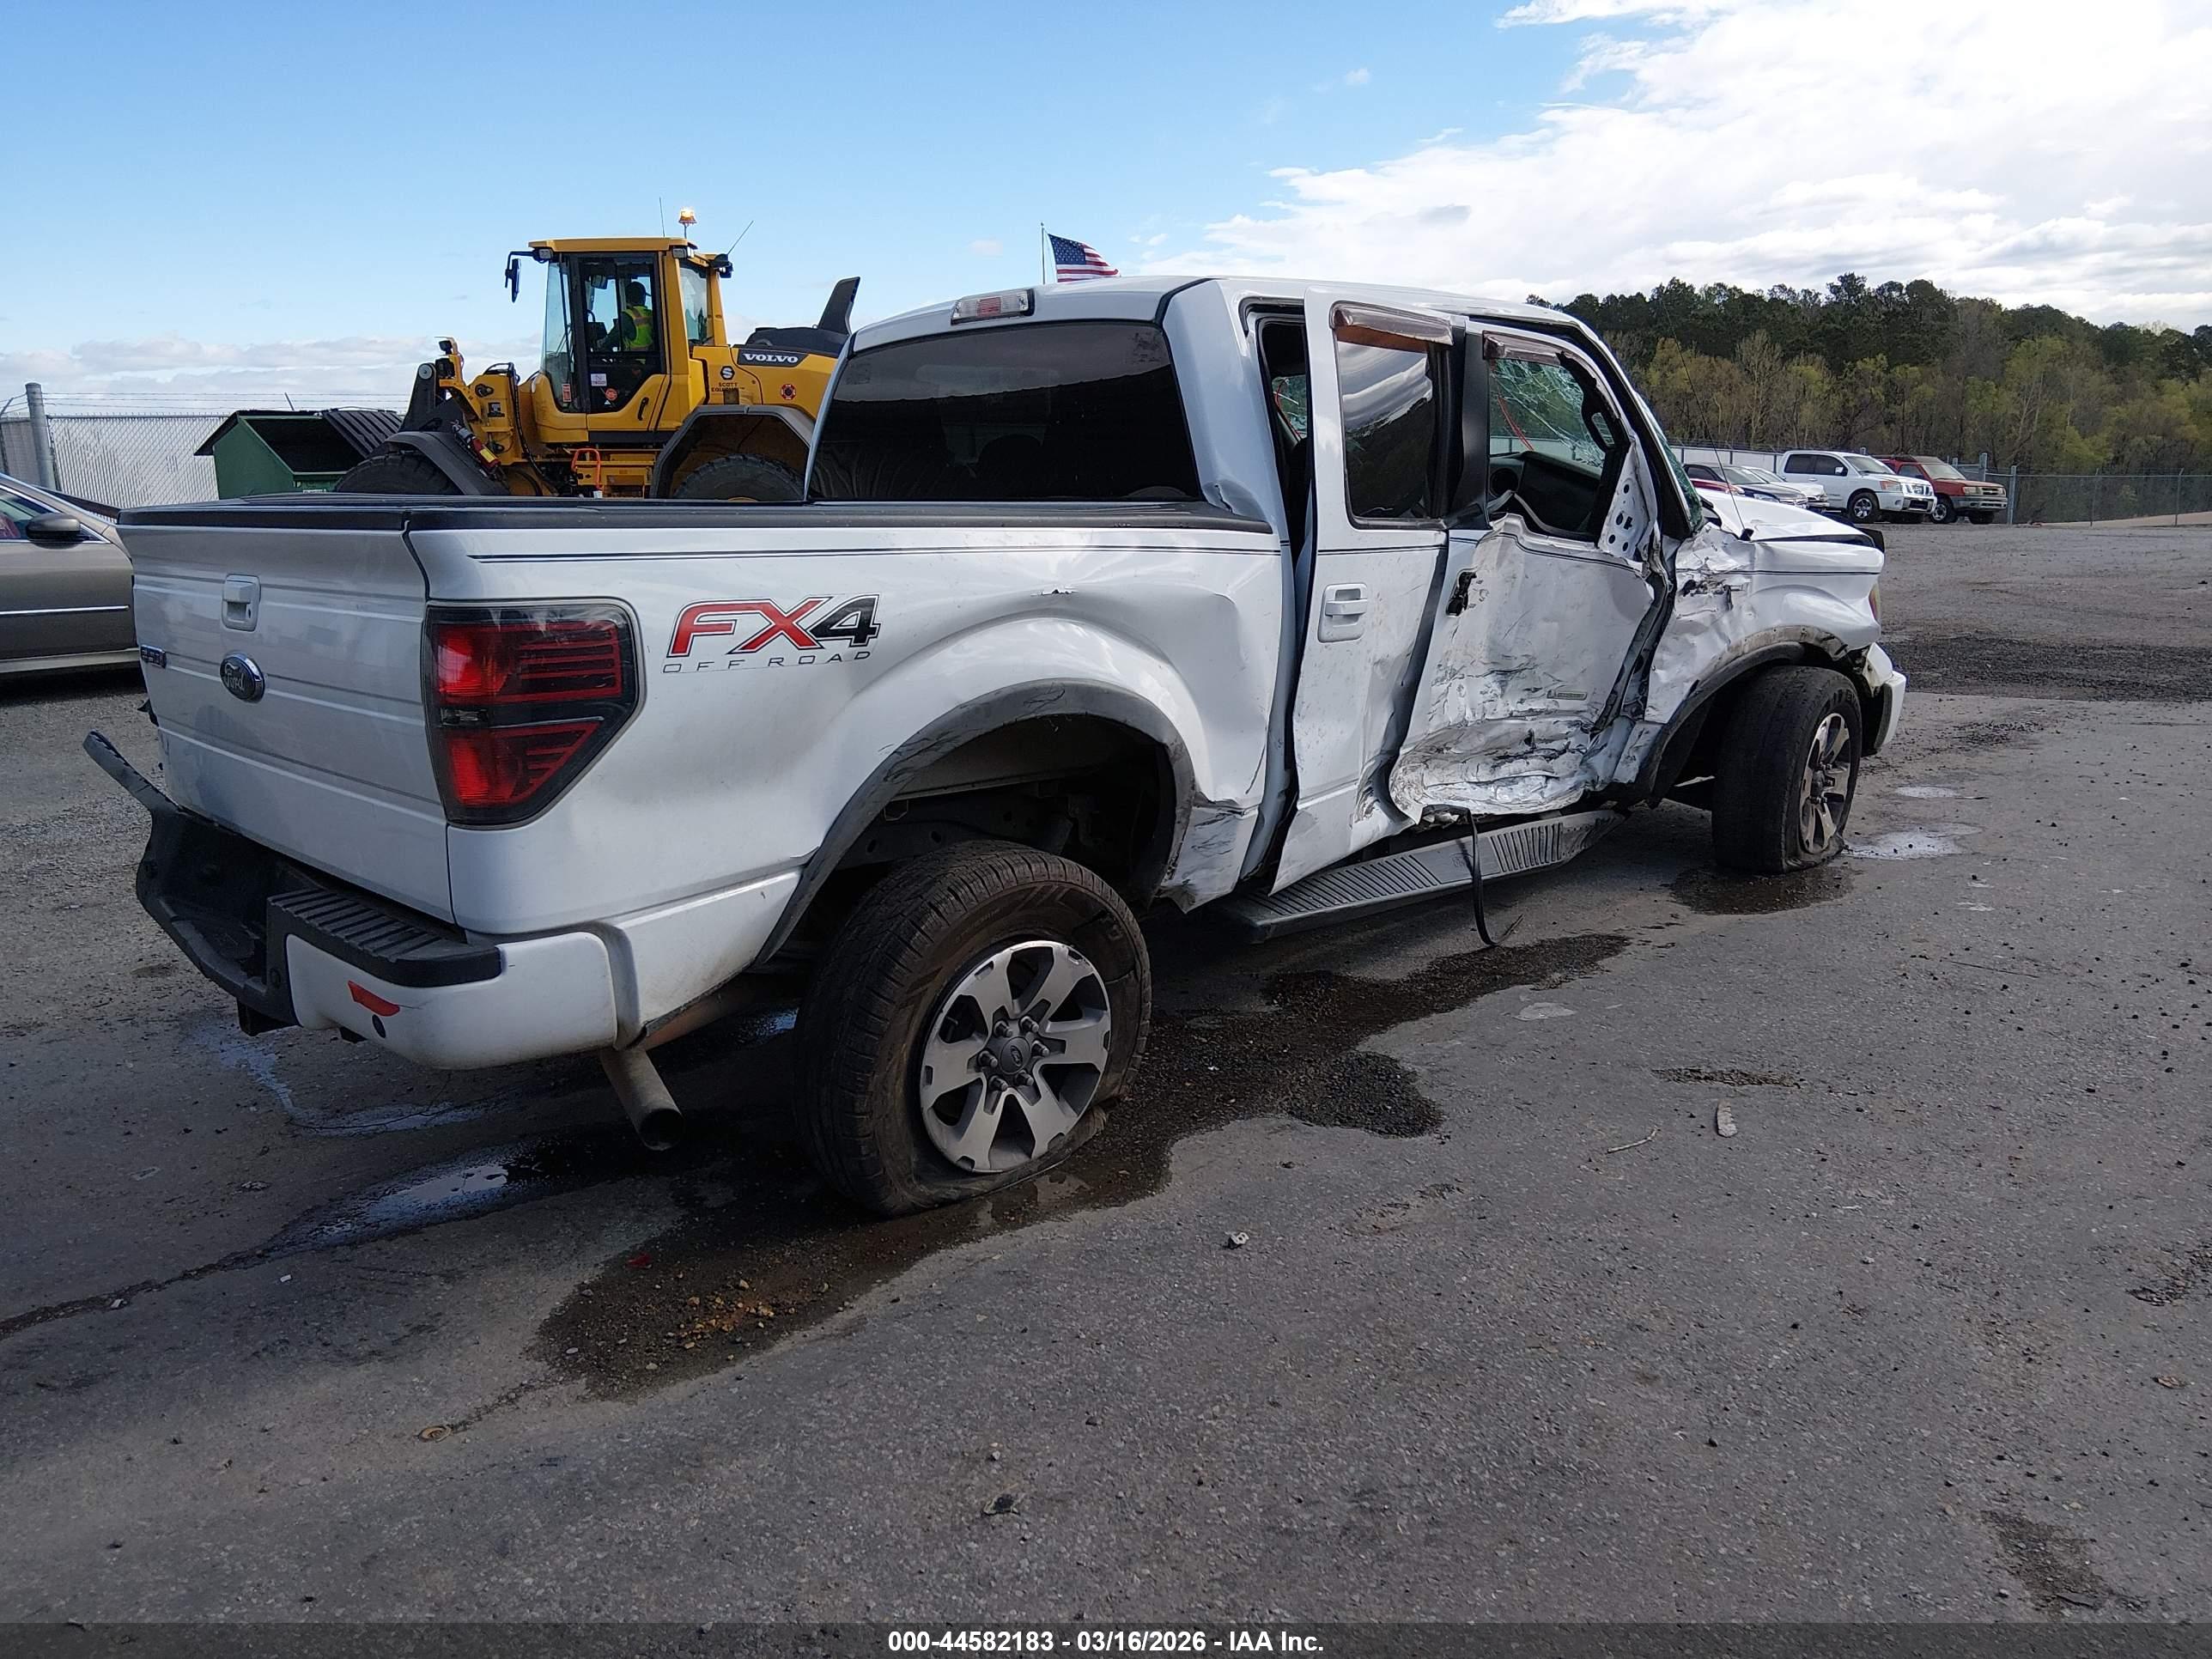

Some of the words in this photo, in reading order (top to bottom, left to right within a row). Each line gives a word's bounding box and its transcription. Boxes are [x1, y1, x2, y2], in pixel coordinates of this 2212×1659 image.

[742, 353, 799, 363] VOLVO
[665, 592, 882, 659] FX4
[662, 659, 746, 674] OFF
[767, 650, 872, 668] ROAD
